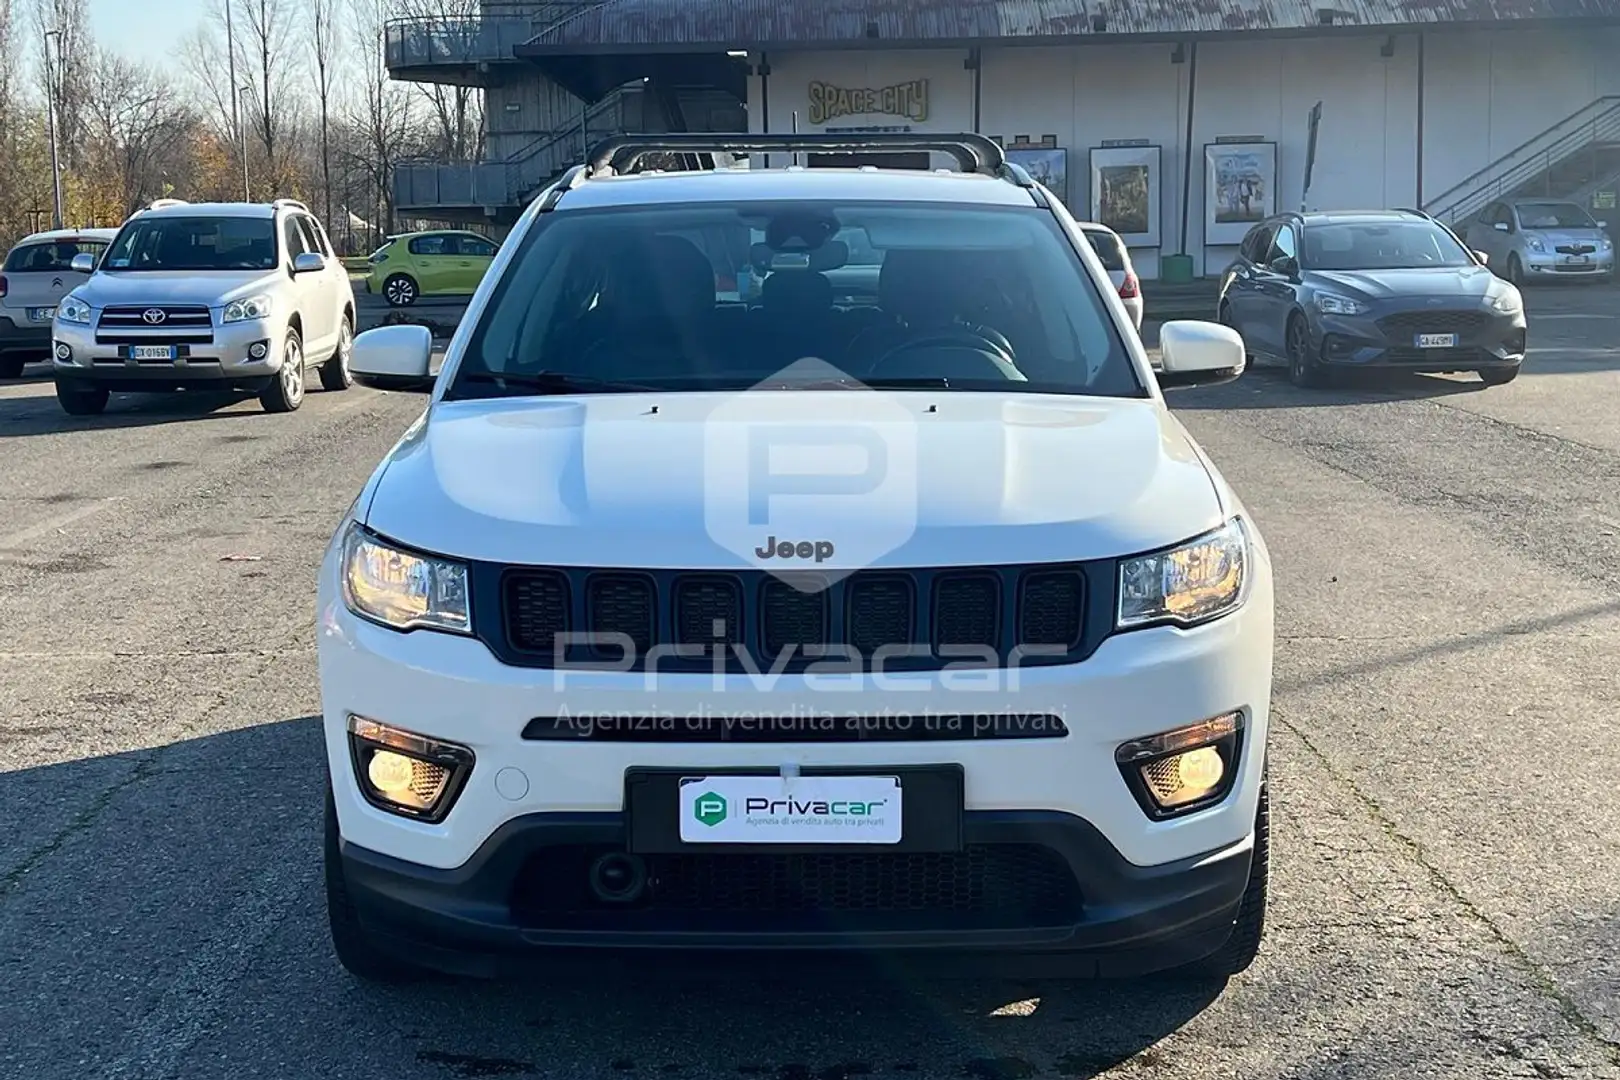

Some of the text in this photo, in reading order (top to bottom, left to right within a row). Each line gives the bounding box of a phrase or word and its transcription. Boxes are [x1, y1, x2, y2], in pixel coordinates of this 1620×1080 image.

[809, 78, 929, 124] SPACE CITY
[755, 536, 834, 562] Jeep
[746, 795, 884, 815] Privacar
[746, 817, 885, 827] Agenzia di vendita auto tra privati
